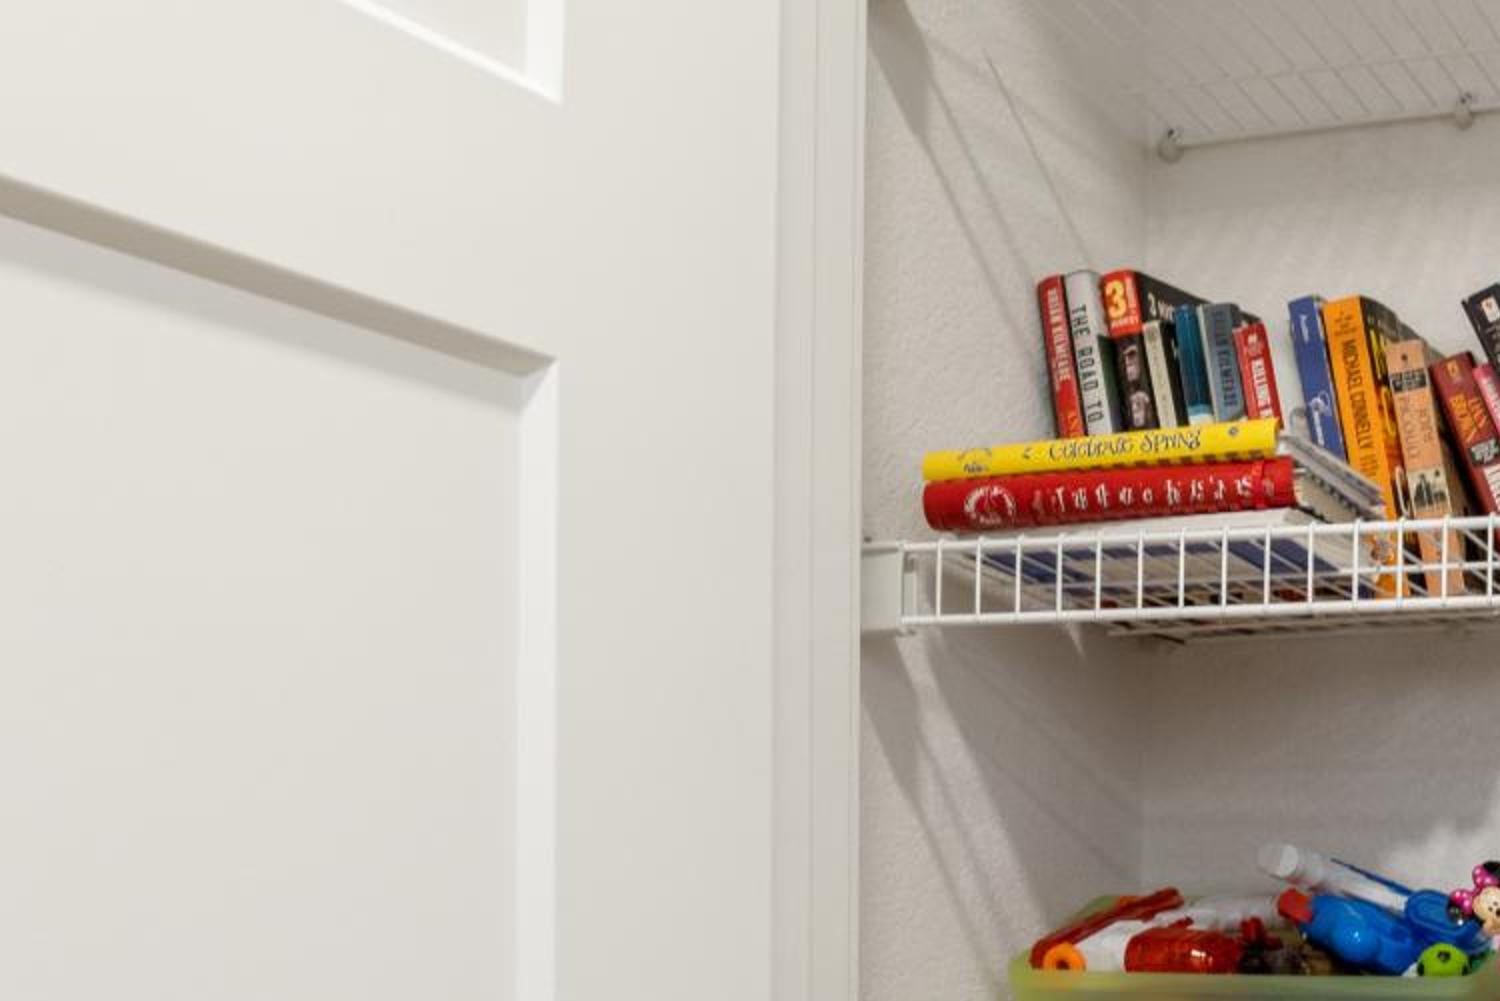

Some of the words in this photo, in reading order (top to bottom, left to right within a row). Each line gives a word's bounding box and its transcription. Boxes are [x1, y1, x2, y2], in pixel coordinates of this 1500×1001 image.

[1071, 304, 1090, 336] THE
[1105, 280, 1126, 319] 3
[1078, 347, 1099, 397] ROAD
[1343, 338, 1363, 389] MICHAEL
[1086, 406, 1105, 424] TO
[1352, 390, 1374, 450] CONNELLY
